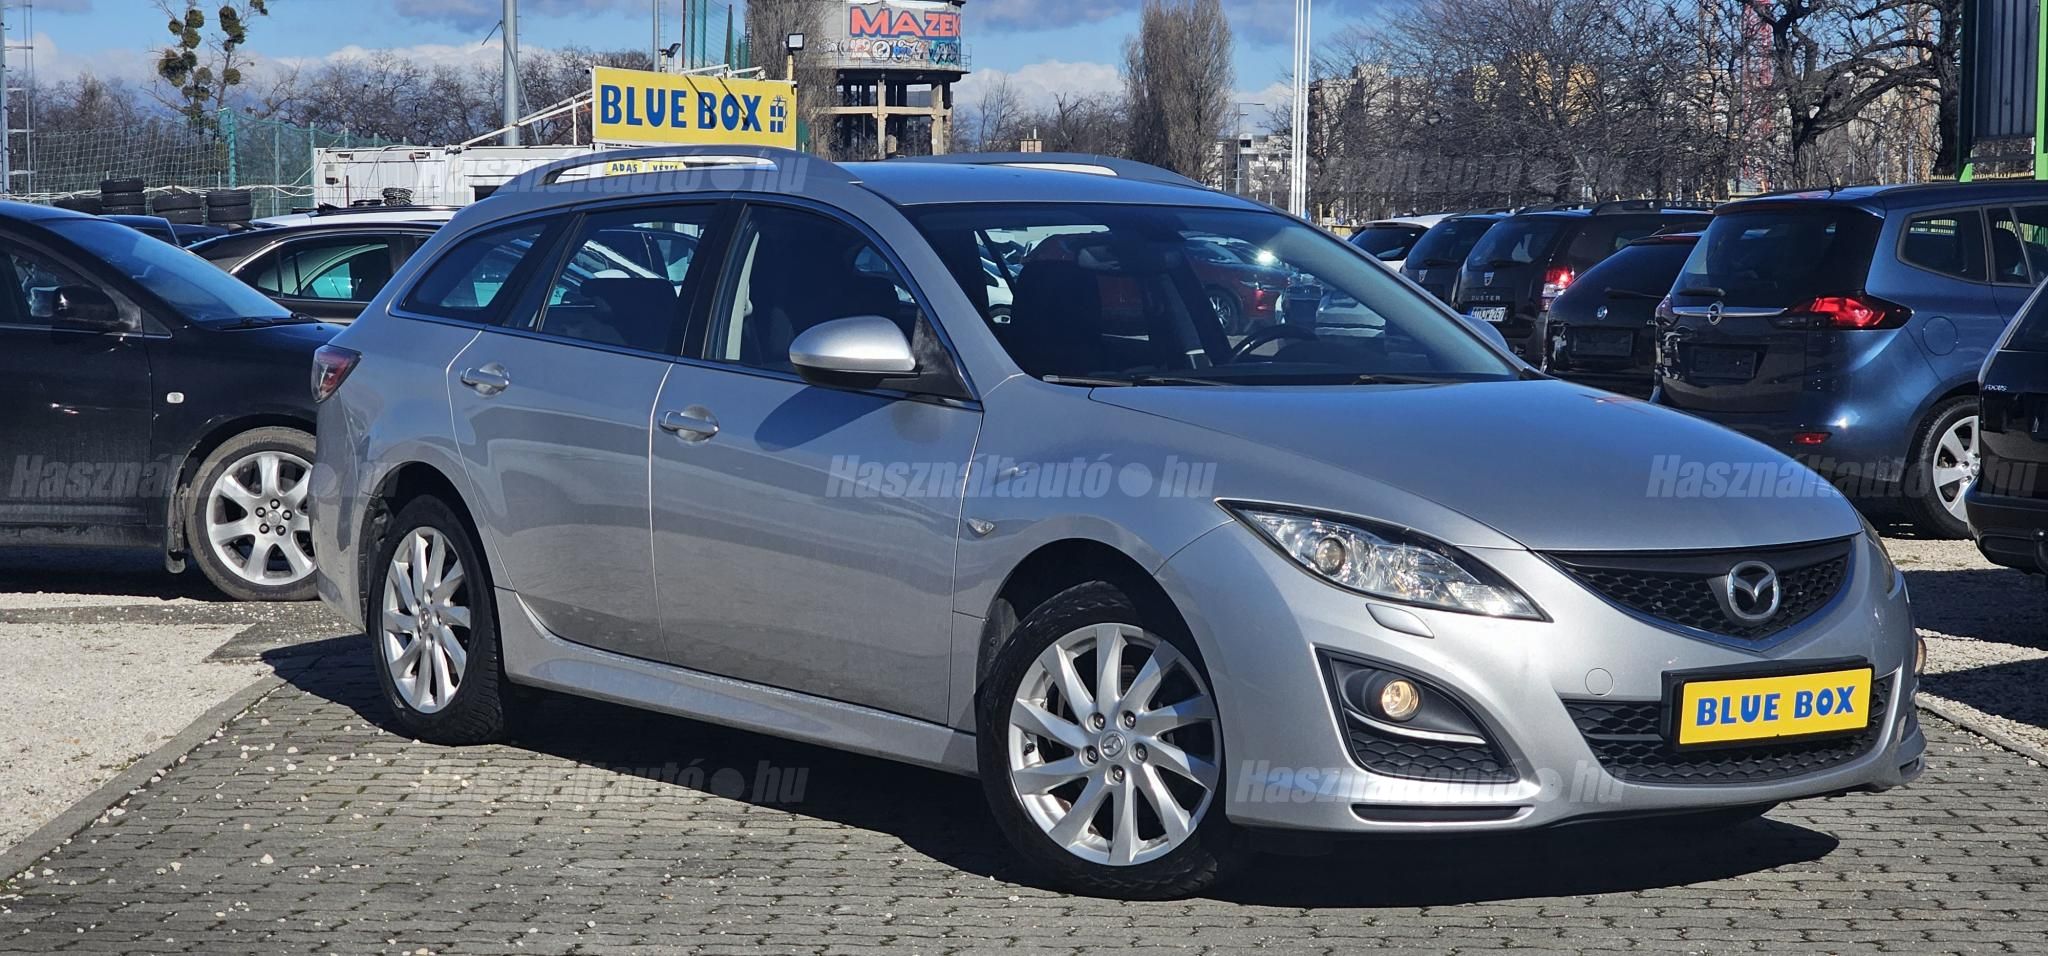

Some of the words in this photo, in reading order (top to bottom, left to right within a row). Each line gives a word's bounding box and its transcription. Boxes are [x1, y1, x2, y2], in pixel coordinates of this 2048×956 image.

[600, 84, 687, 128] BLUE
[697, 91, 762, 132] BOX
[1696, 693, 1780, 726] BLUE
[1794, 686, 1856, 719] BOX
